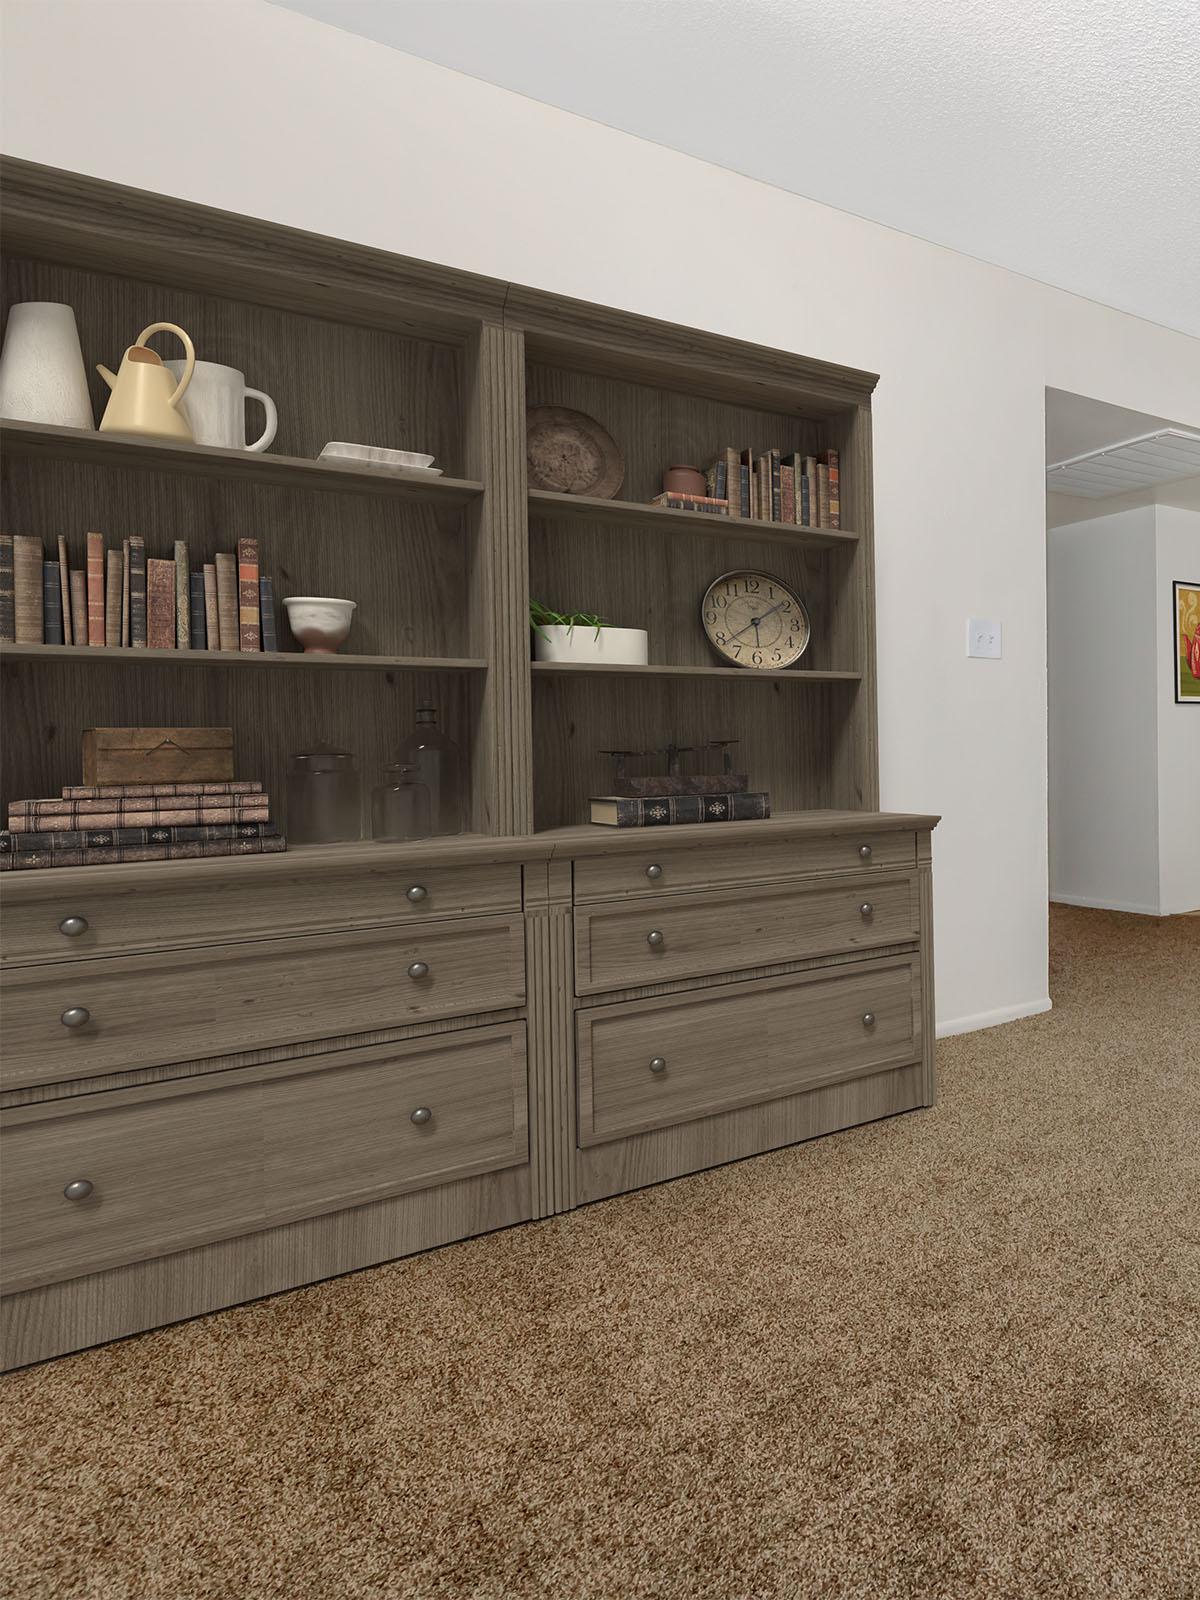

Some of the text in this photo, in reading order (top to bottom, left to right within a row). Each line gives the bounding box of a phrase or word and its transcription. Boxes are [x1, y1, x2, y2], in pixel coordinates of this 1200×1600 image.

[726, 583, 738, 596] 11
[745, 580, 760, 594] 12
[768, 586, 775, 599] 1
[711, 595, 727, 608] 10
[782, 600, 791, 613] 2
[706, 611, 717, 624] 9
[790, 619, 800, 632] 3
[716, 632, 726, 646] 8
[784, 635, 794, 648] 4
[732, 645, 742, 658] 7
[752, 651, 762, 665] 6
[772, 648, 781, 661] 5
